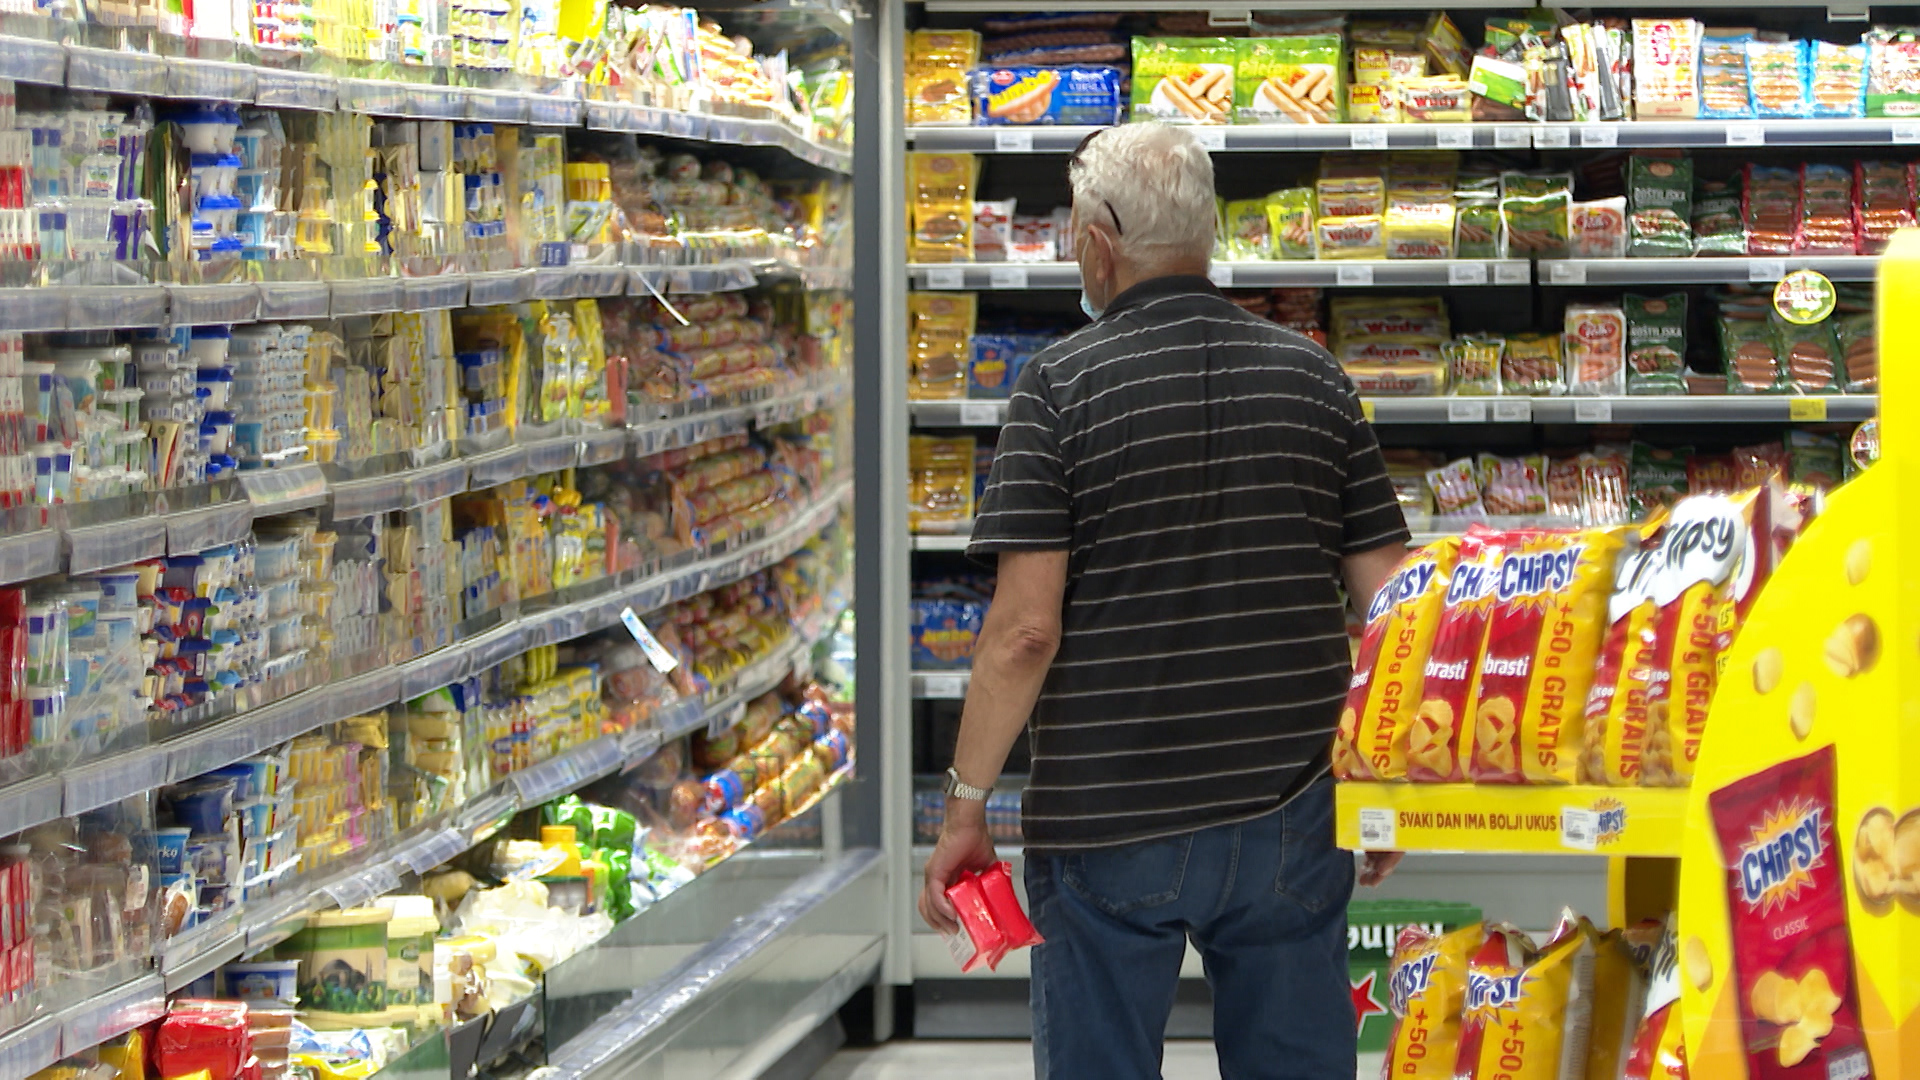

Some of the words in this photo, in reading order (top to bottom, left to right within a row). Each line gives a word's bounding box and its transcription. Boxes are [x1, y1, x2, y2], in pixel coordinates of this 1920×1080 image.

[1371, 681, 1403, 769] GRATIS
[1537, 675, 1567, 769] GRATIS
[1399, 812, 1434, 829] SVAKI
[1436, 812, 1462, 829] DAN
[1464, 813, 1487, 830] IMA
[1489, 813, 1523, 831] BOLJI
[1525, 814, 1558, 832] UKUS
[1772, 915, 1810, 941] CLASSIC
